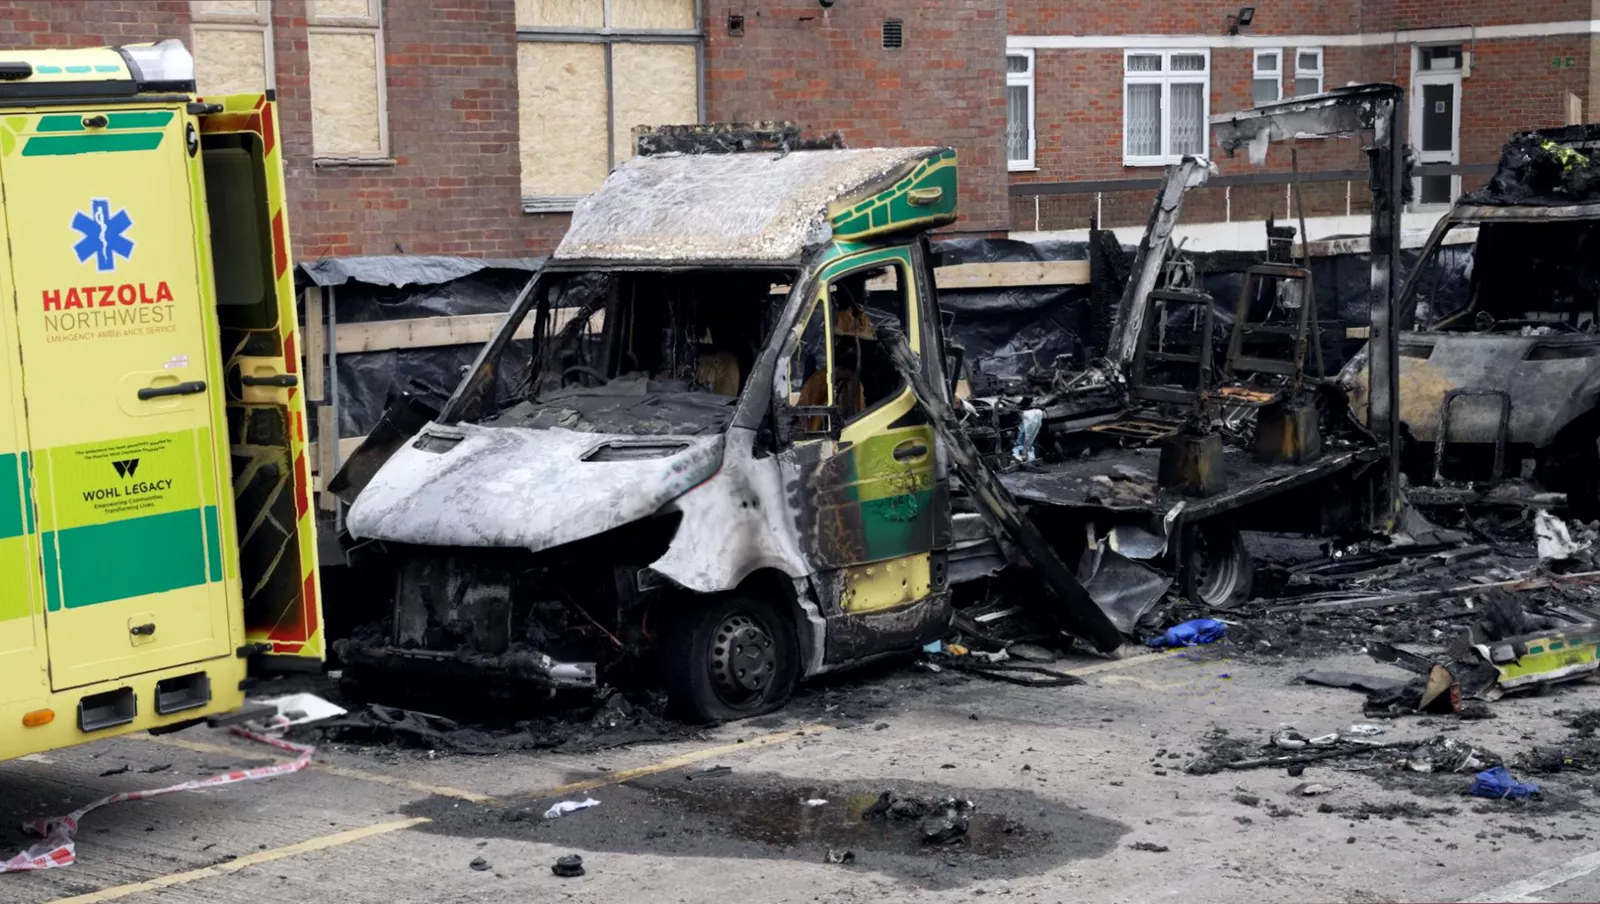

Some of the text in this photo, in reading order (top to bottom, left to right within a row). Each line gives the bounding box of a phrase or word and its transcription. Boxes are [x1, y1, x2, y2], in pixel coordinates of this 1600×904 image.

[42, 281, 174, 312] HATZOLA
[44, 305, 175, 332] NORTHWEST
[46, 324, 177, 344] EMERGENCY AMBULANCE SERVICE
[82, 478, 173, 502] WOHL LEGACY
